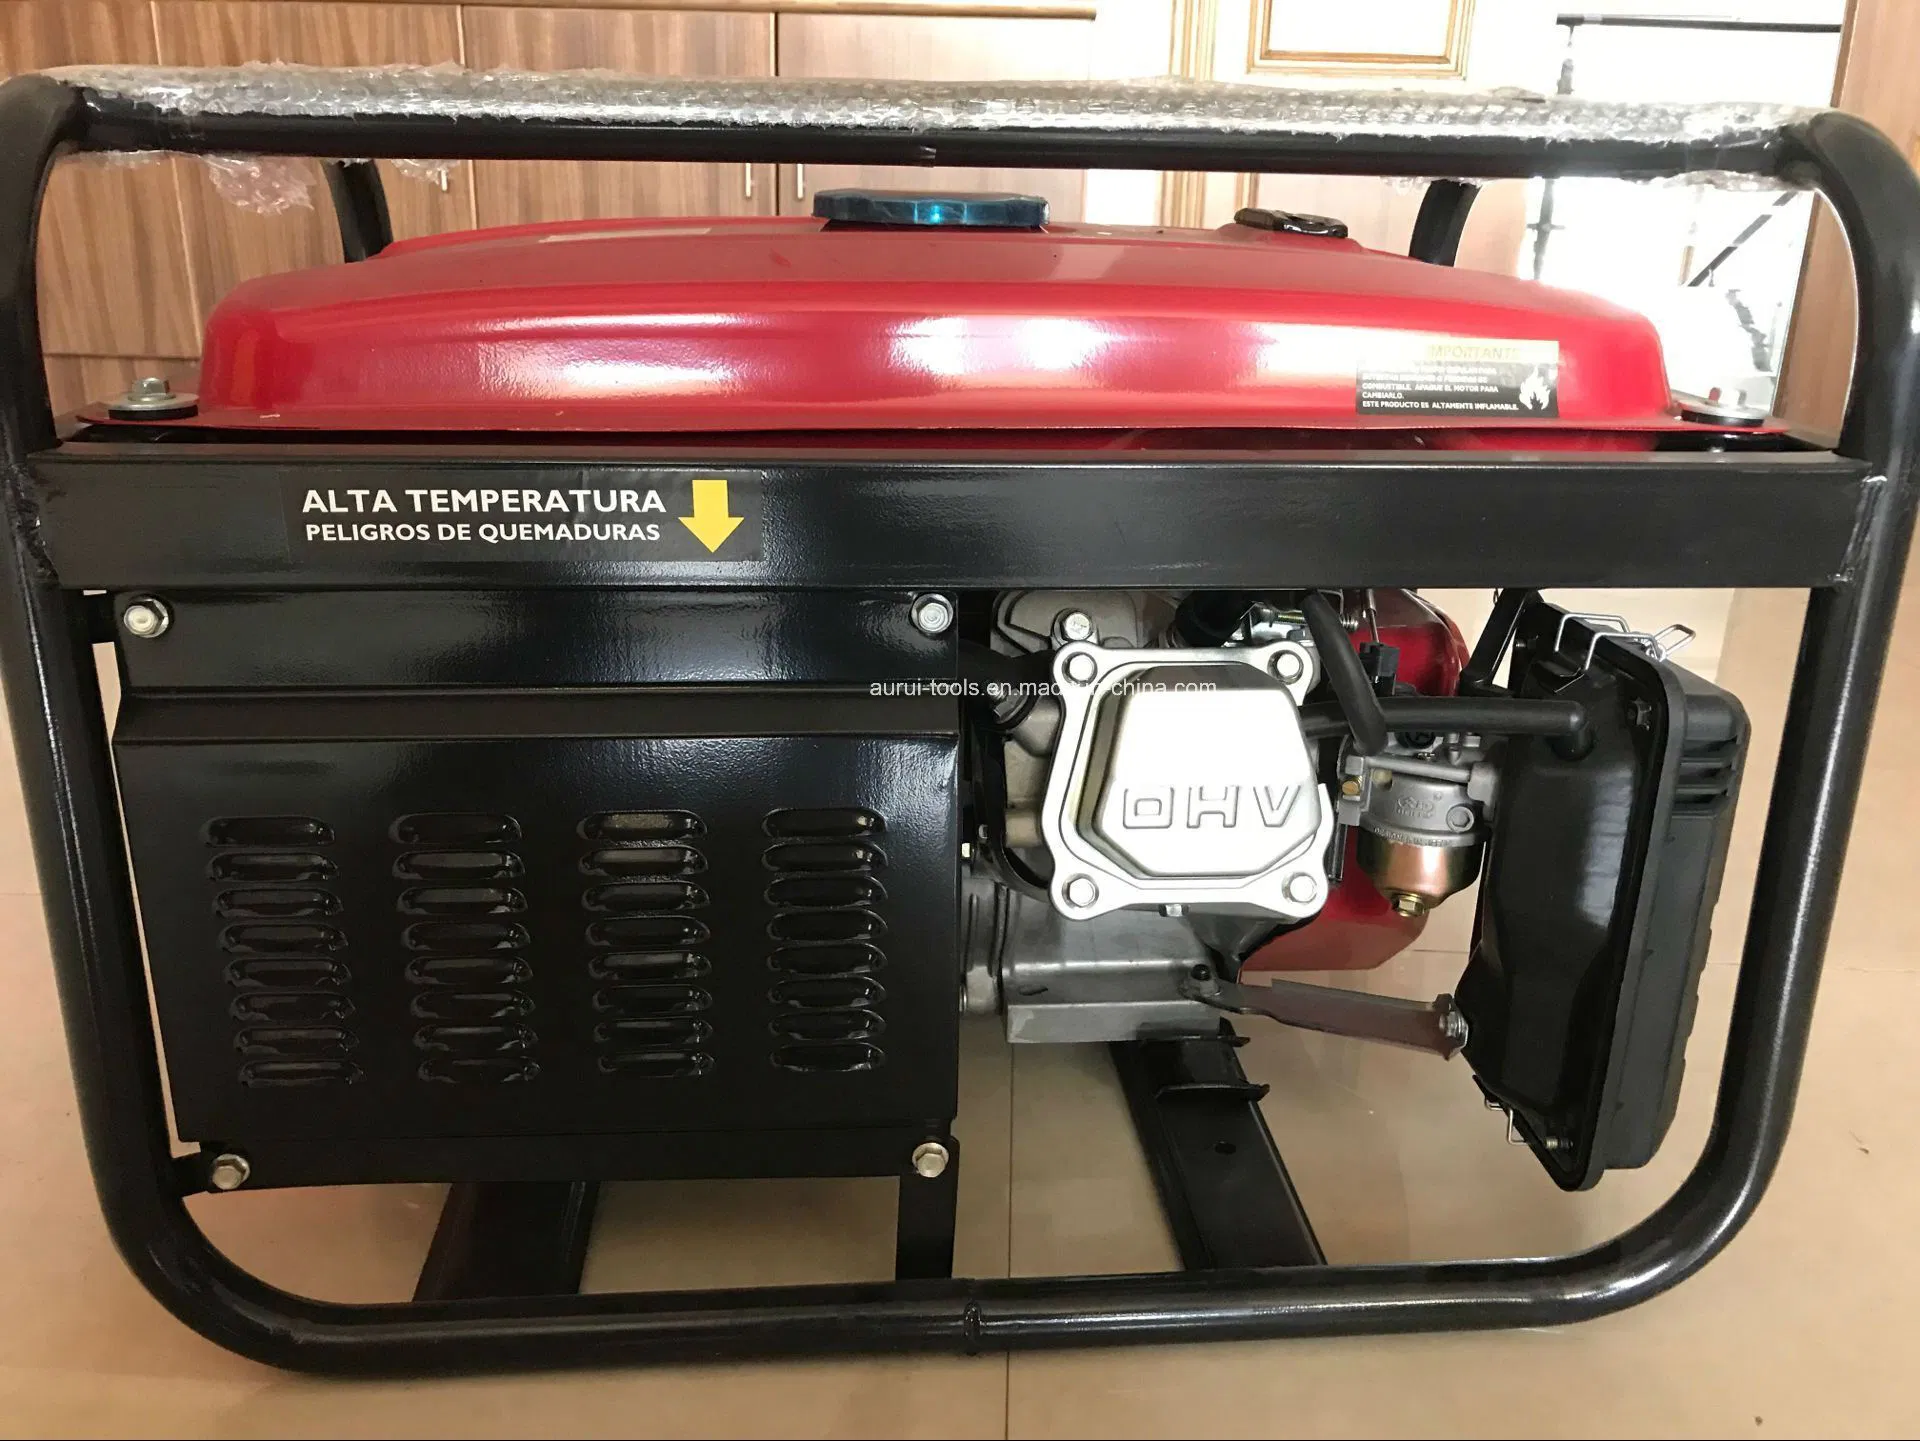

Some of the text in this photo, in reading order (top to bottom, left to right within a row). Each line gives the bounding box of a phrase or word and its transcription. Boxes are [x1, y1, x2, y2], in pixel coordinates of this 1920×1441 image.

[302, 489, 668, 513] ALTA TEMPERATURA
[305, 523, 660, 544] PELIGROS DE QUEMADURAS
[1122, 784, 1303, 830] OHV
